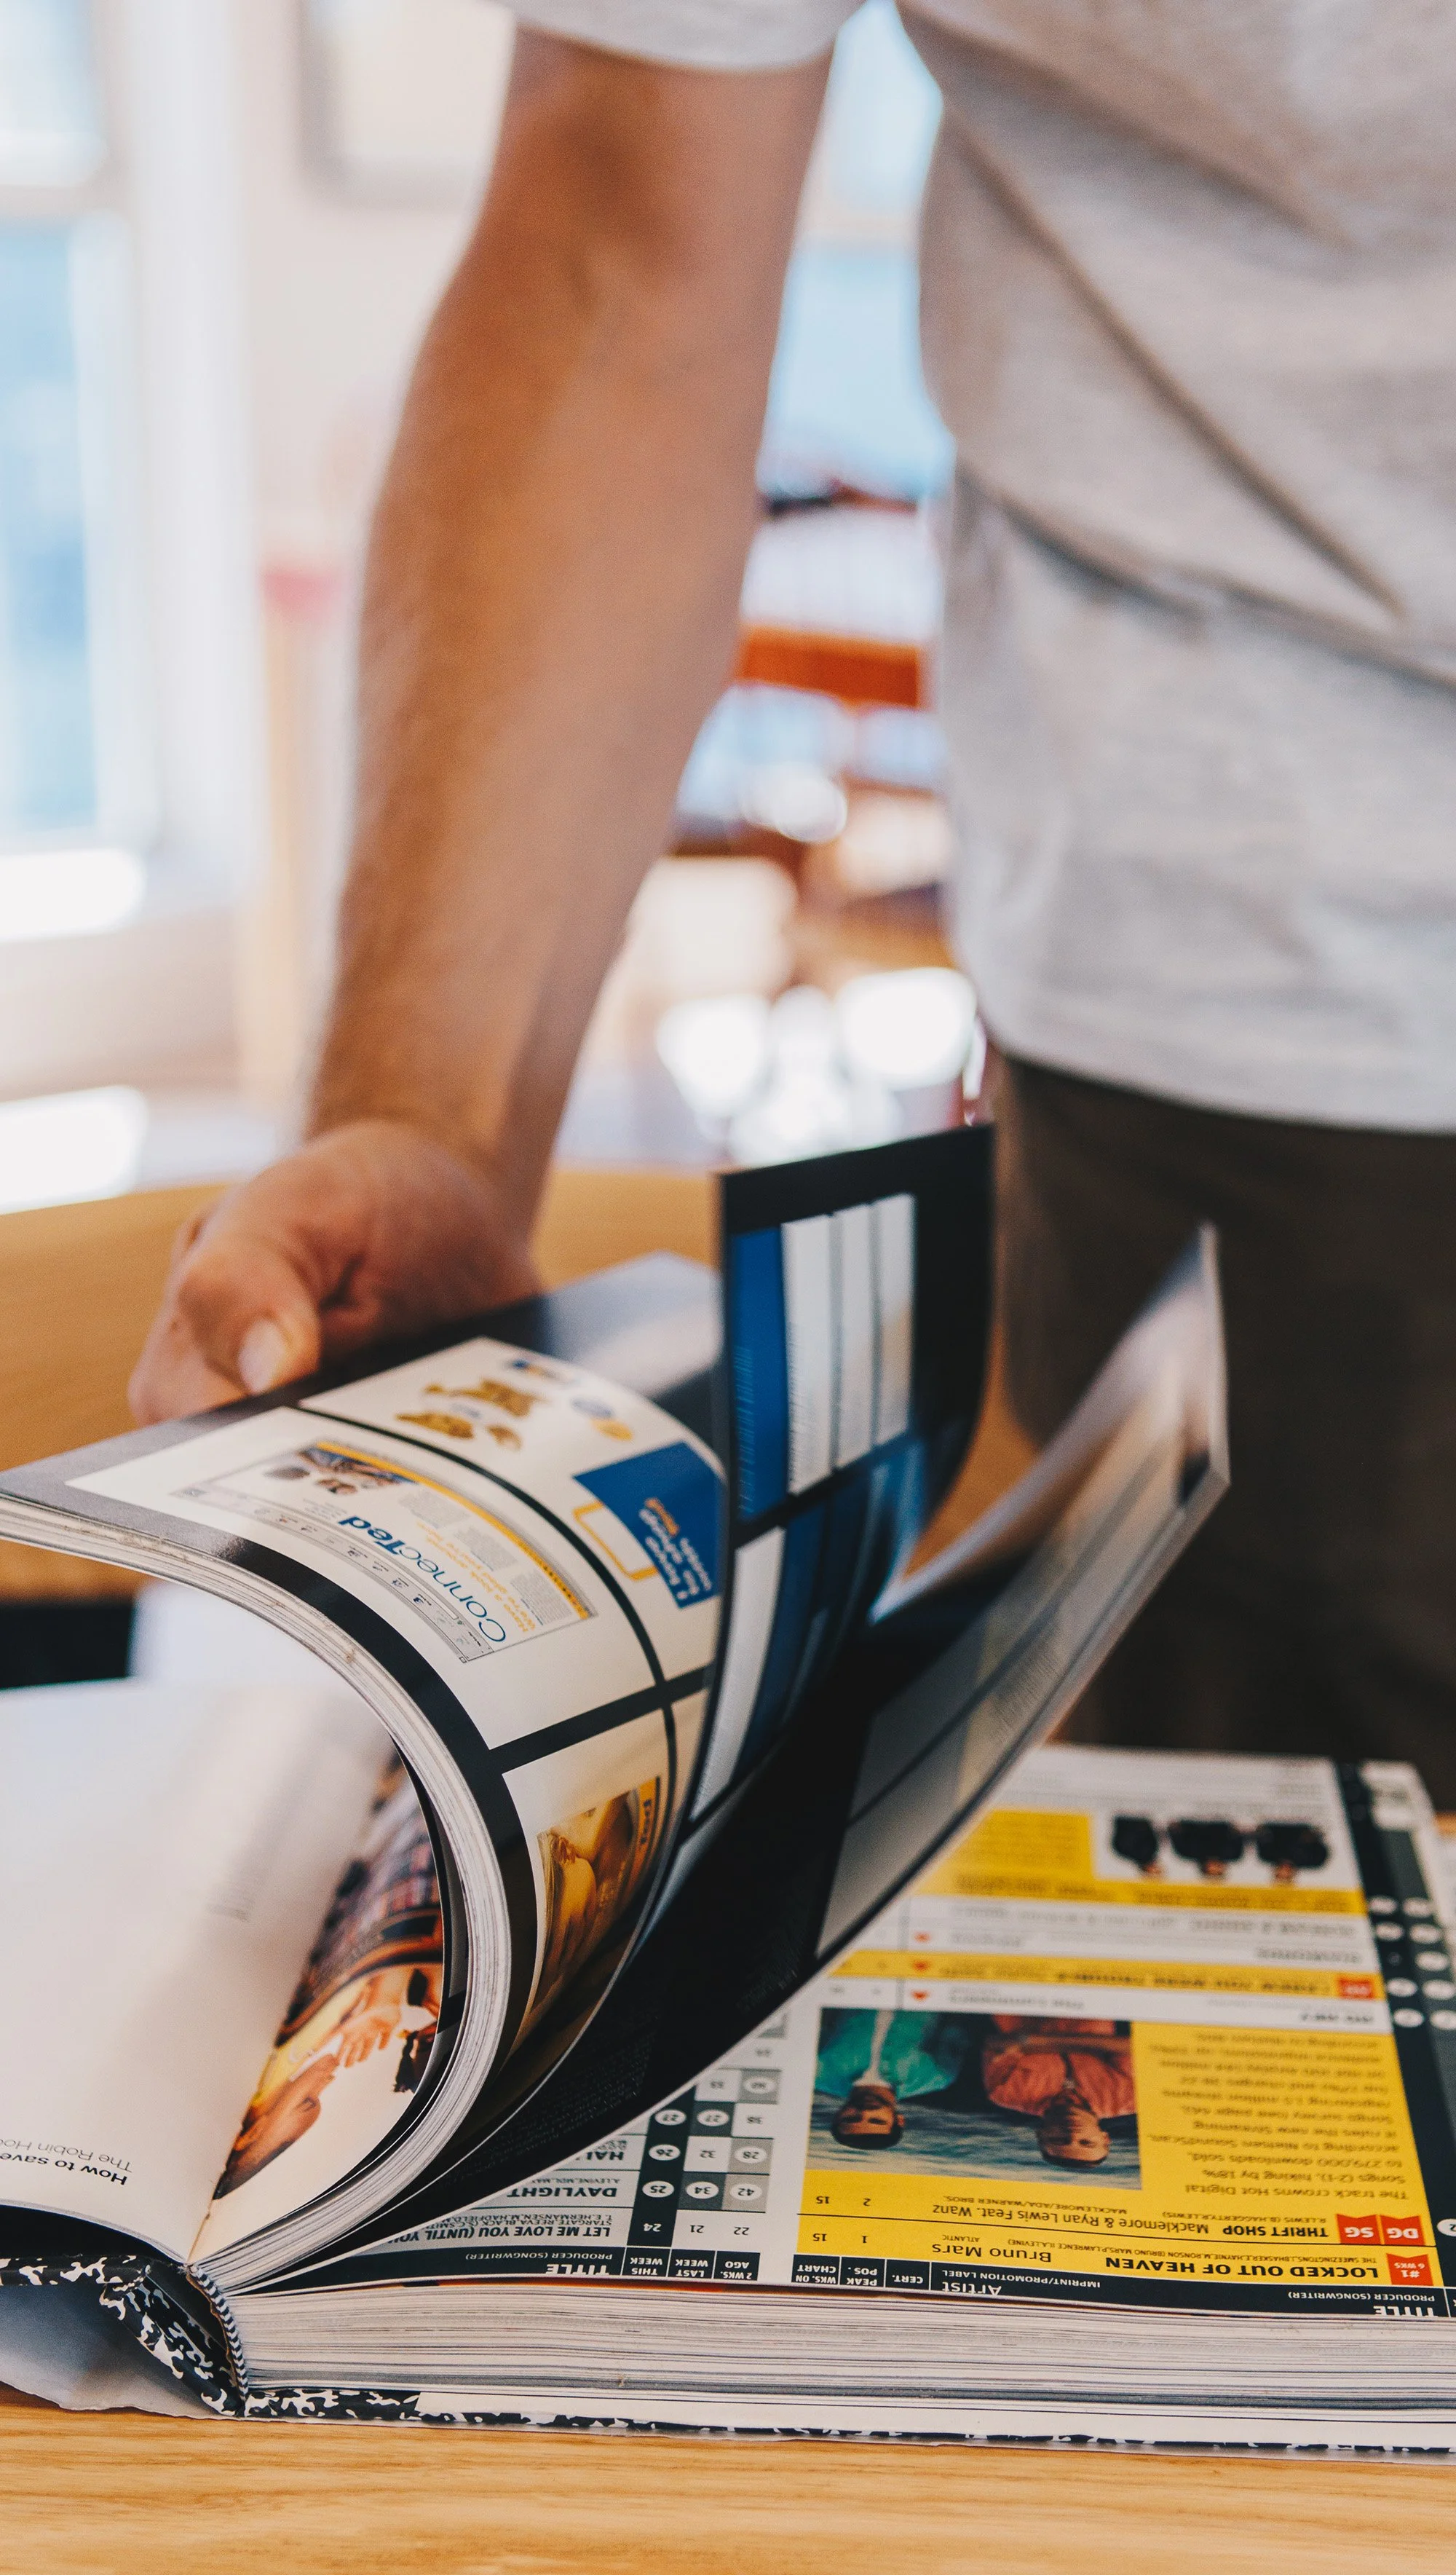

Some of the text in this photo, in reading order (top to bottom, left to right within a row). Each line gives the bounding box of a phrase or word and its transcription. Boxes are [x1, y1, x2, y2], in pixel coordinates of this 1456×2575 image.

[338, 1516, 506, 1643] ConnecTed
[37, 2143, 94, 2161] Robin
[657, 2149, 673, 2157] 26
[700, 2150, 716, 2158] 32
[743, 2151, 759, 2159] 28
[98, 2154, 132, 2173] The
[0, 2153, 127, 2185] How to save
[507, 2188, 617, 2198] DAYLIGHT
[650, 2185, 666, 2193] 25
[695, 2186, 711, 2194] 34
[737, 2188, 754, 2196] 42
[1185, 2184, 1407, 2200] The track crowns Hot Digital
[863, 2198, 871, 2206] 2
[933, 2204, 1208, 2233] Macklemore & Ryan Lewis Feat. Wanz
[514, 2227, 552, 2236] LOVE
[557, 2227, 579, 2236] ME
[583, 2227, 610, 2236] LET
[644, 2223, 662, 2231] 24
[689, 2225, 704, 2233] 21
[734, 2227, 750, 2235] 22
[1222, 2225, 1328, 2237] THRIFT SHOP
[425, 2227, 475, 2240] (UNTIL
[478, 2227, 509, 2237] YOU
[1345, 2227, 1374, 2238] SG
[1386, 2228, 1419, 2239] DG
[812, 2233, 827, 2241] 15
[862, 2236, 868, 2244] 1
[465, 2252, 548, 2260] (SONGWRITER)
[932, 2244, 1051, 2263] Bruno Mars
[630, 2257, 662, 2265] WEEK
[676, 2259, 708, 2267] WEEK
[545, 2264, 609, 2275] TITLE
[797, 2265, 836, 2274] CHART
[1105, 2257, 1378, 2278] LOCKED OUT OF HEAVEN
[676, 2269, 705, 2277] LAST
[1401, 2270, 1420, 2278] #1
[795, 2274, 836, 2284] WKS. ON
[847, 2277, 877, 2286] PEAK
[892, 2275, 923, 2284] CERT.
[941, 2270, 1100, 2288] IMPRINT/PROMOTION LABEL
[941, 2282, 1002, 2296] Artist
[1288, 2292, 1435, 2302] PRODUCER (SONGWRITER)
[1373, 2306, 1439, 2317] TITLE
